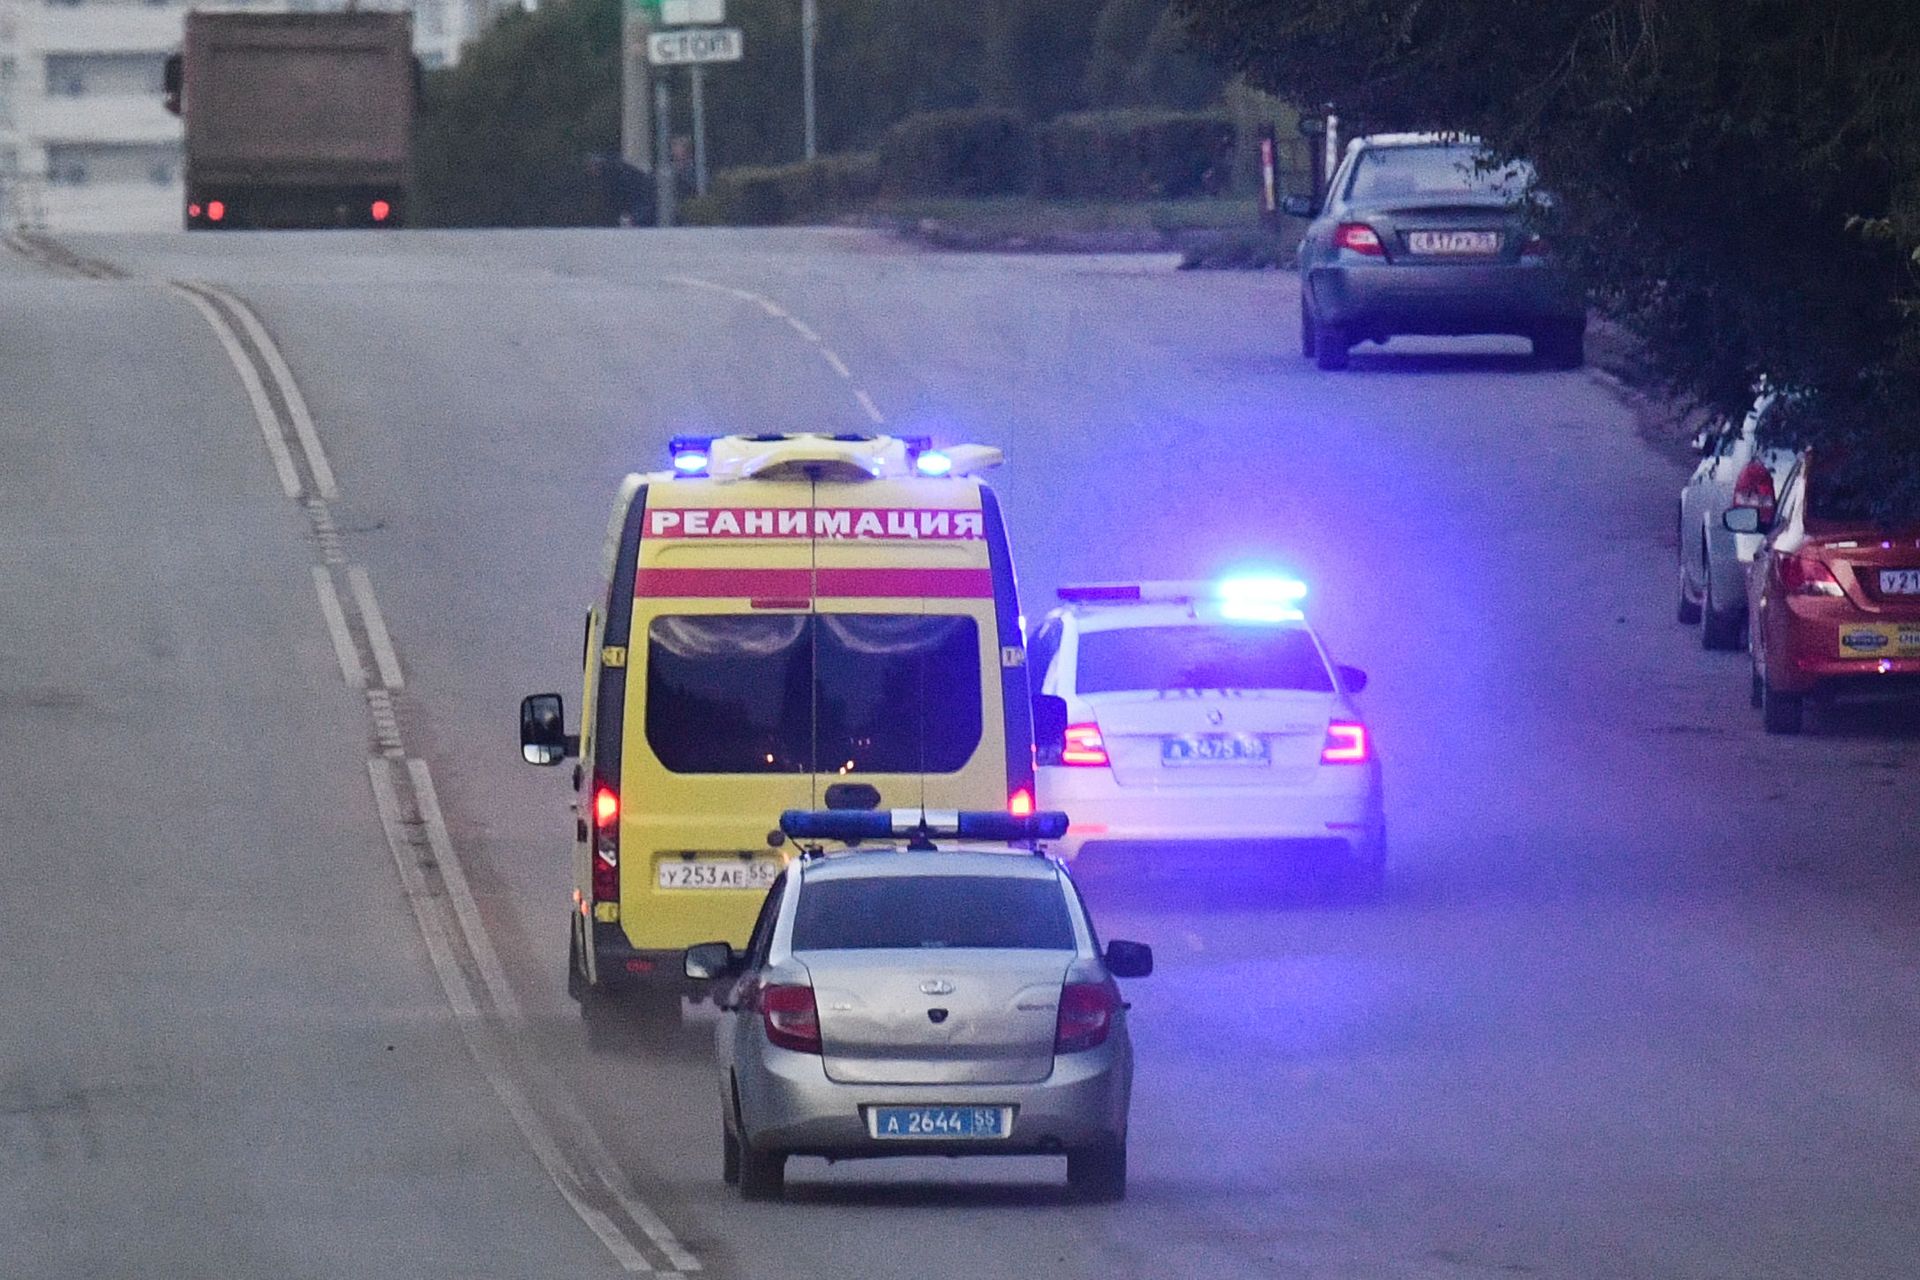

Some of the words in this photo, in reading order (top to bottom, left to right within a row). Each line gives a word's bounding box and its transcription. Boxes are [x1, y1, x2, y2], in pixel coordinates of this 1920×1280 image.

[656, 33, 736, 59] СТОП
[650, 510, 983, 537] РЕАНИМАЦИЯ
[974, 1106, 995, 1127] 55
